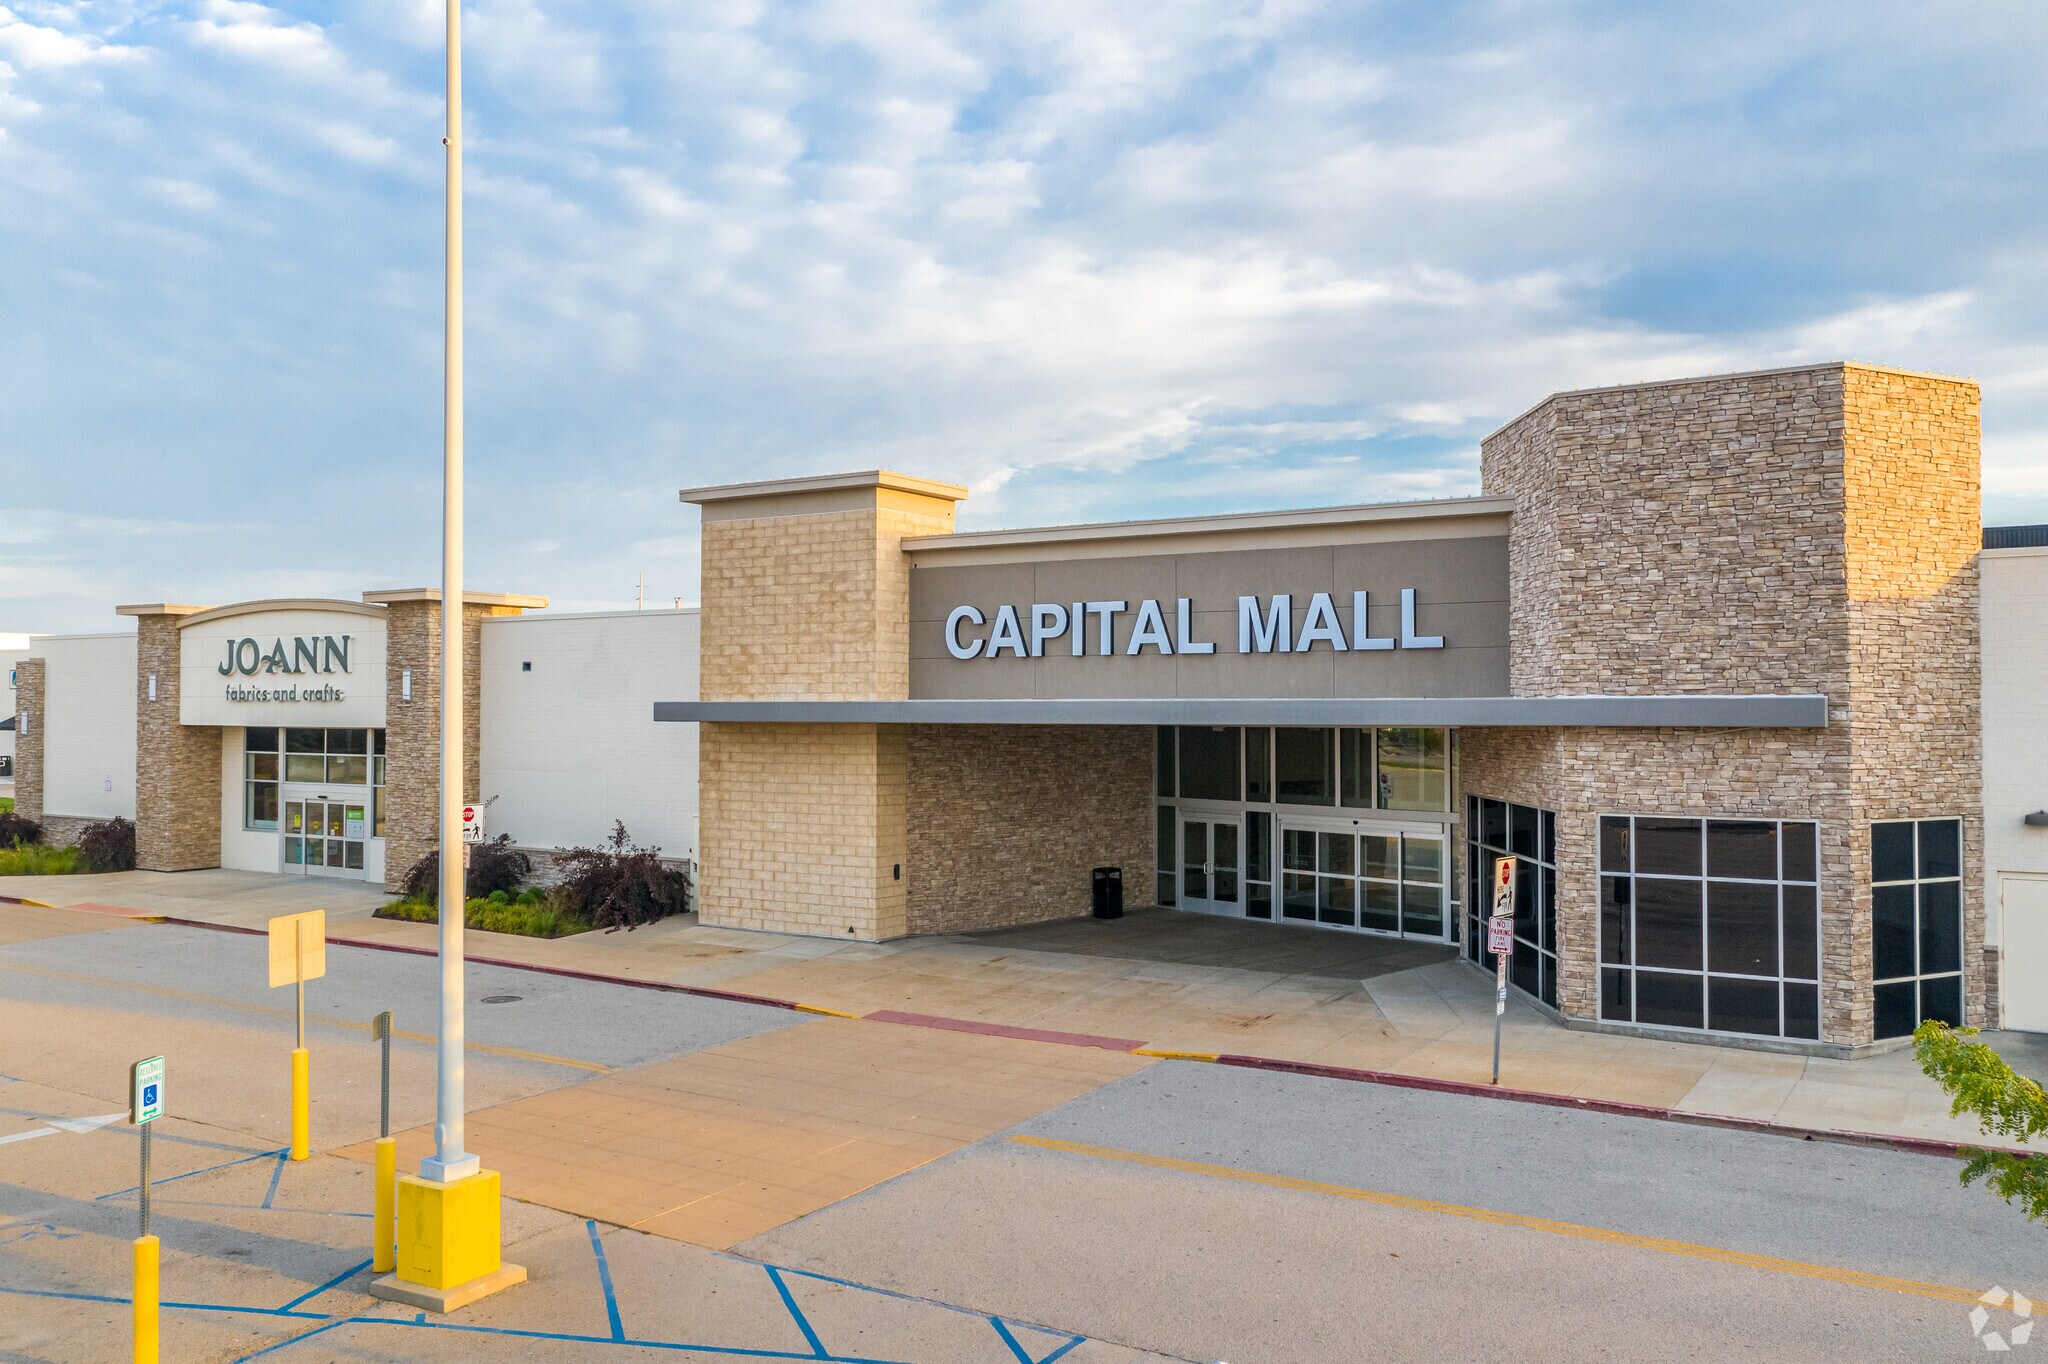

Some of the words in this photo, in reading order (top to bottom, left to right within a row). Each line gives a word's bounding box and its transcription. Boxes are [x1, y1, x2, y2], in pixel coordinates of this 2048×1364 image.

[945, 598, 1217, 660] CAPITAL
[1238, 588, 1446, 655] MALL
[226, 684, 269, 702] fabrics
[273, 684, 297, 702] and
[303, 683, 342, 702] crafts
[1497, 921, 1506, 929] NO
[1491, 928, 1511, 936] PARKING
[140, 1063, 162, 1076] RESERVED
[140, 1073, 162, 1086] PARKING
